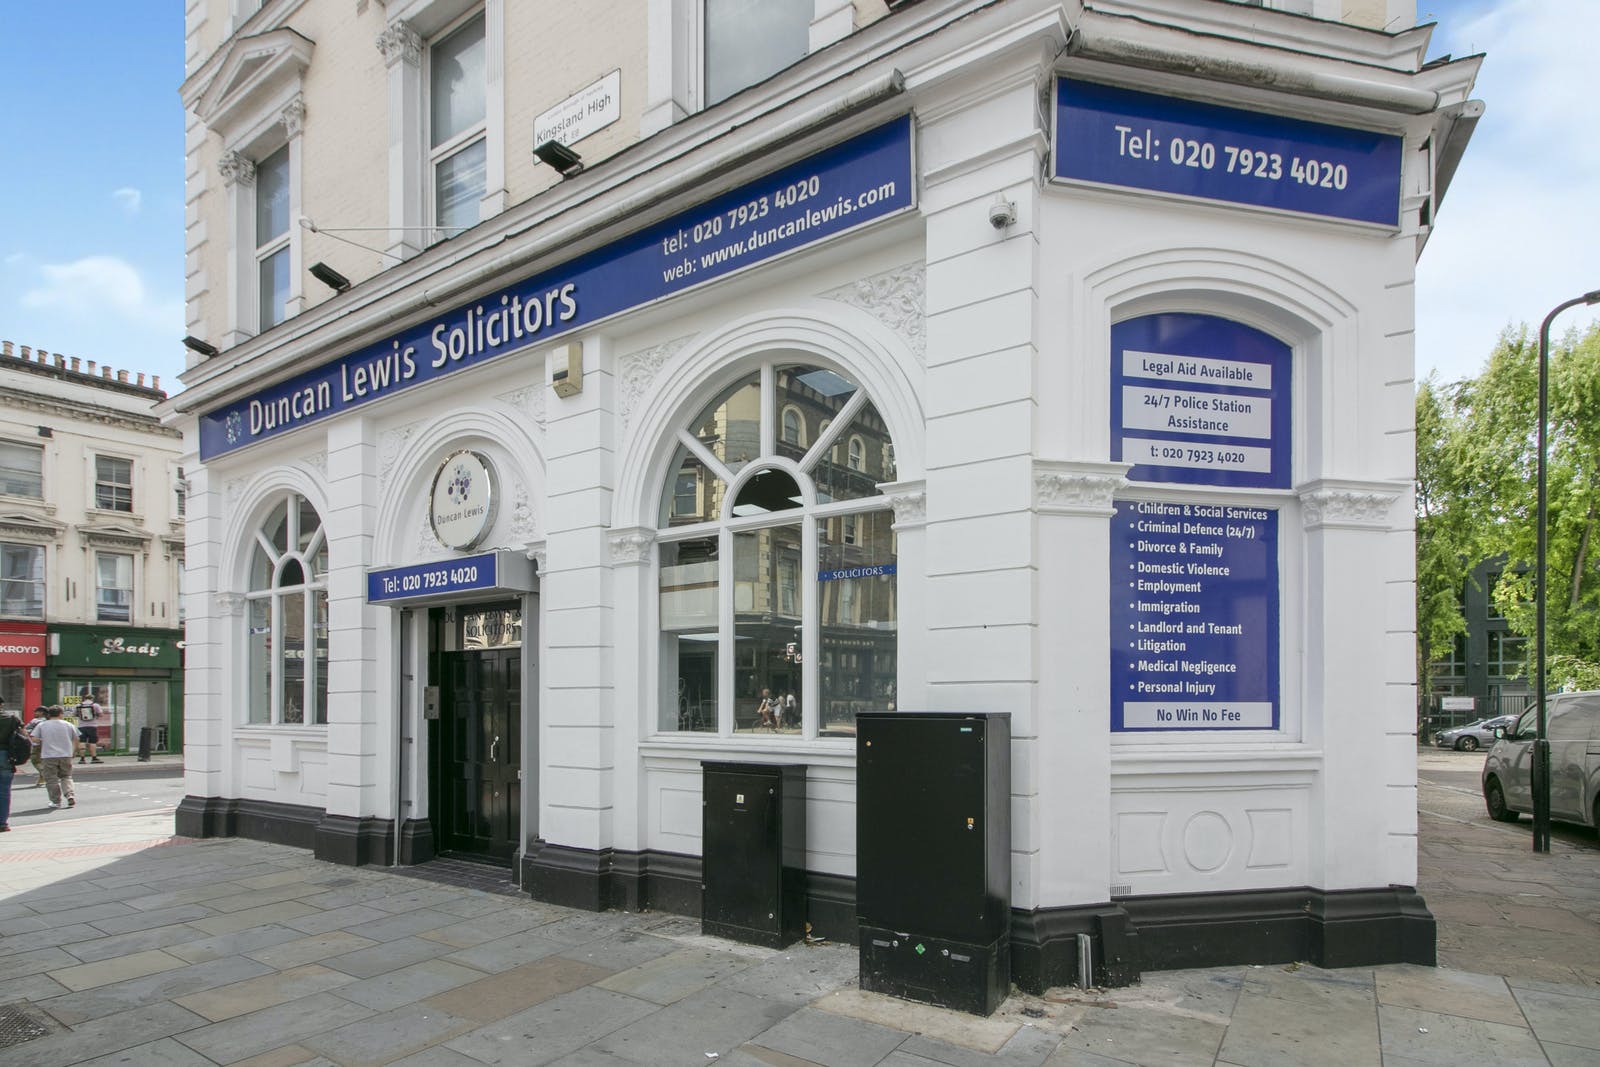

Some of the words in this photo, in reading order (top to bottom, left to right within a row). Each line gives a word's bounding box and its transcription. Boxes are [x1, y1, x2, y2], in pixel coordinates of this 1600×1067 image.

[537, 107, 583, 144] Kingsland
[588, 94, 611, 116] High
[1115, 126, 1159, 161] Tel:
[1170, 138, 1215, 169] 020
[1224, 147, 1282, 180] 7923
[1291, 158, 1348, 190] 4020
[663, 231, 688, 256] tel:
[693, 216, 722, 244] 020
[728, 198, 769, 229] 7923
[774, 176, 819, 208] 4020
[663, 257, 695, 282] web:
[701, 179, 895, 269] www.duncanlewis.com
[250, 380, 331, 435] Duncan
[342, 341, 415, 402] Lewis
[432, 283, 577, 368] Solicitors
[1143, 359, 1174, 375] Legal
[1178, 362, 1196, 375] Aid
[1200, 365, 1252, 381] Available
[1144, 395, 1170, 408] 24/7
[1174, 396, 1208, 410] Police
[1212, 399, 1251, 413] Station
[1168, 415, 1228, 431] Assistance
[1151, 446, 1158, 457] t:
[1163, 448, 1183, 458] 020
[1188, 450, 1213, 463] 7923
[1218, 452, 1245, 463] 4020
[437, 512, 462, 524] Duncan
[464, 505, 484, 519] Lewis
[1138, 503, 1180, 515] Children
[1184, 506, 1190, 515] &
[1194, 506, 1223, 517] Social
[1227, 508, 1267, 520] Services
[1138, 521, 1180, 533] Criminal
[1184, 523, 1223, 536] Defence
[1226, 525, 1255, 538] (24/7)
[1138, 541, 1176, 553] Divorce
[1179, 543, 1186, 553] &
[1190, 543, 1223, 557] Family
[833, 567, 883, 579] SOLICITORS
[1138, 562, 1184, 574] Domestic
[1187, 564, 1229, 576] Violence
[384, 577, 399, 593] Tel:
[403, 575, 420, 590] 020
[423, 570, 447, 587] 7923
[451, 567, 477, 584] 4020
[1138, 580, 1201, 594] Employment
[1138, 601, 1200, 614] Immigration
[466, 623, 516, 637] SOLICITORS
[1138, 622, 1182, 634] Landlord
[1187, 623, 1204, 634] and
[1208, 624, 1242, 635] Tenant
[0, 645, 40, 654] KROYD
[1138, 640, 1186, 652] Litigation
[1138, 661, 1177, 672] Medical
[1182, 662, 1236, 674] Negligence
[1138, 681, 1182, 692] Personal
[1186, 683, 1215, 695] Injury
[1157, 710, 1172, 720] No
[1177, 709, 1198, 721] Win
[1203, 710, 1217, 721] No
[1222, 710, 1240, 721] Fee
